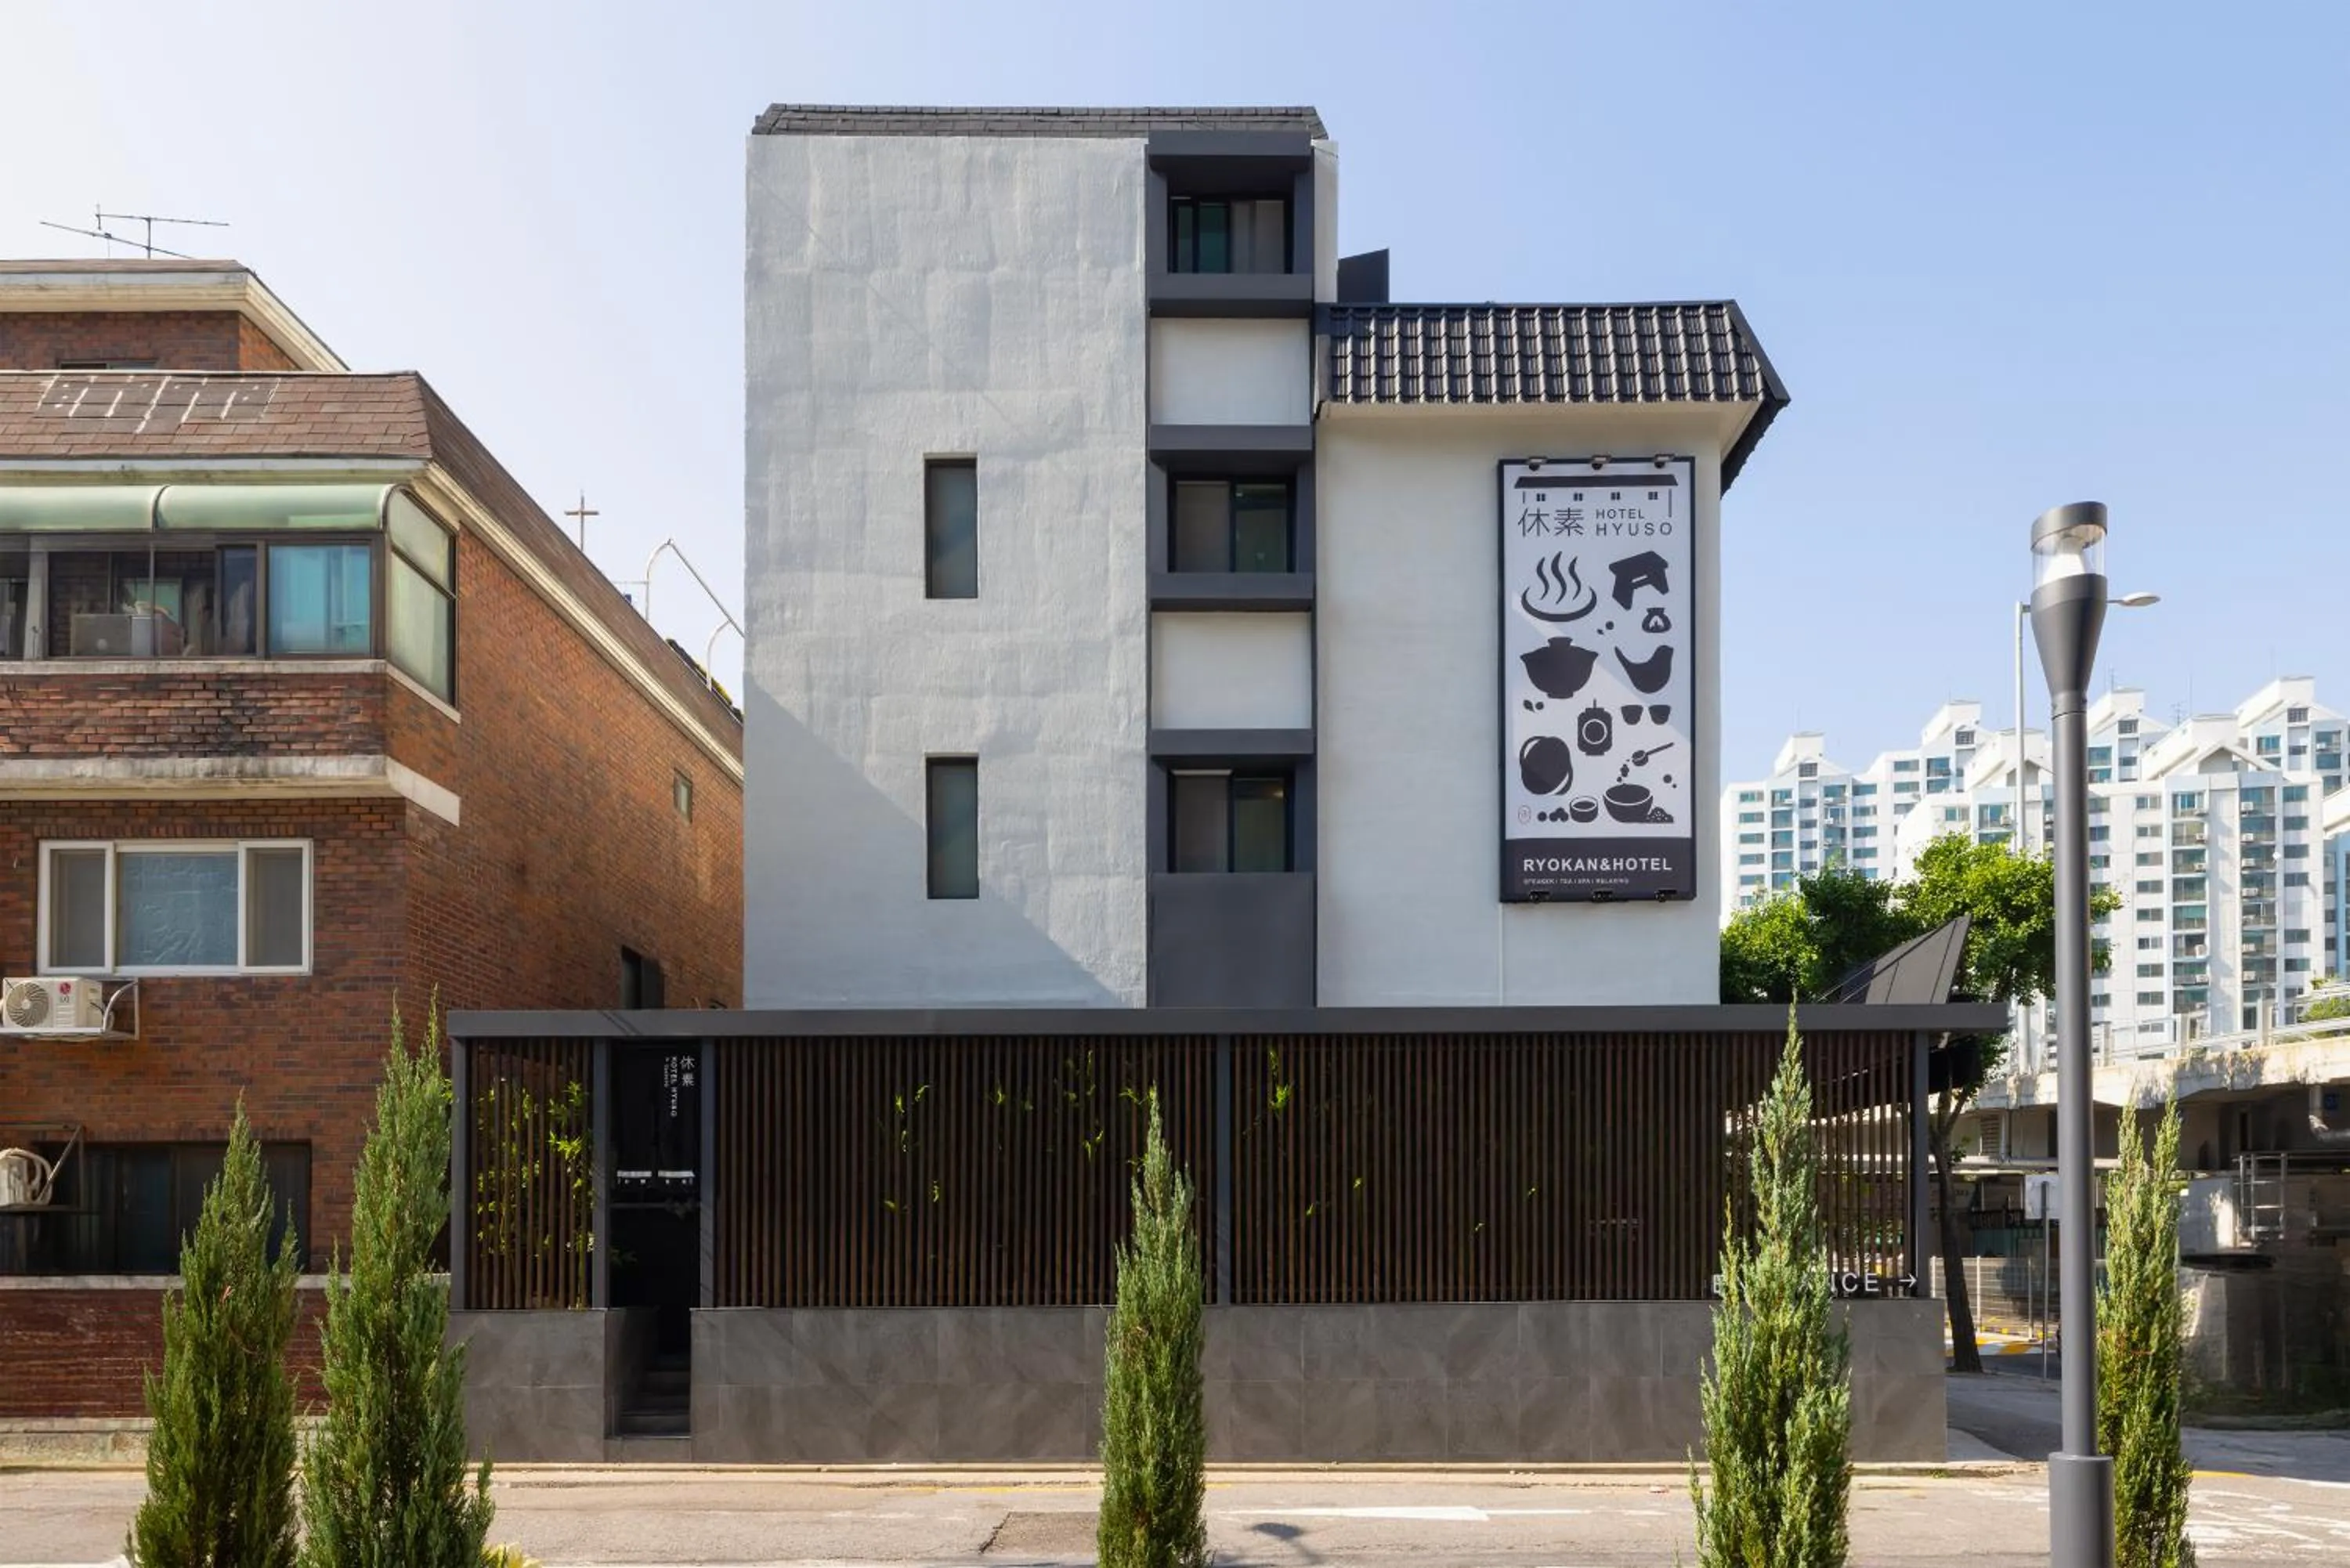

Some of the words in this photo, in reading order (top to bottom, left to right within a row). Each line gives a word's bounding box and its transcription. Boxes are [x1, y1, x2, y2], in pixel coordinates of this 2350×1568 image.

[1596, 508, 1644, 519] HOTEL
[1518, 507, 1585, 537] 休素
[1596, 522, 1672, 537] HYUSO
[1523, 858, 1672, 872] RYOKAN&HOTEL
